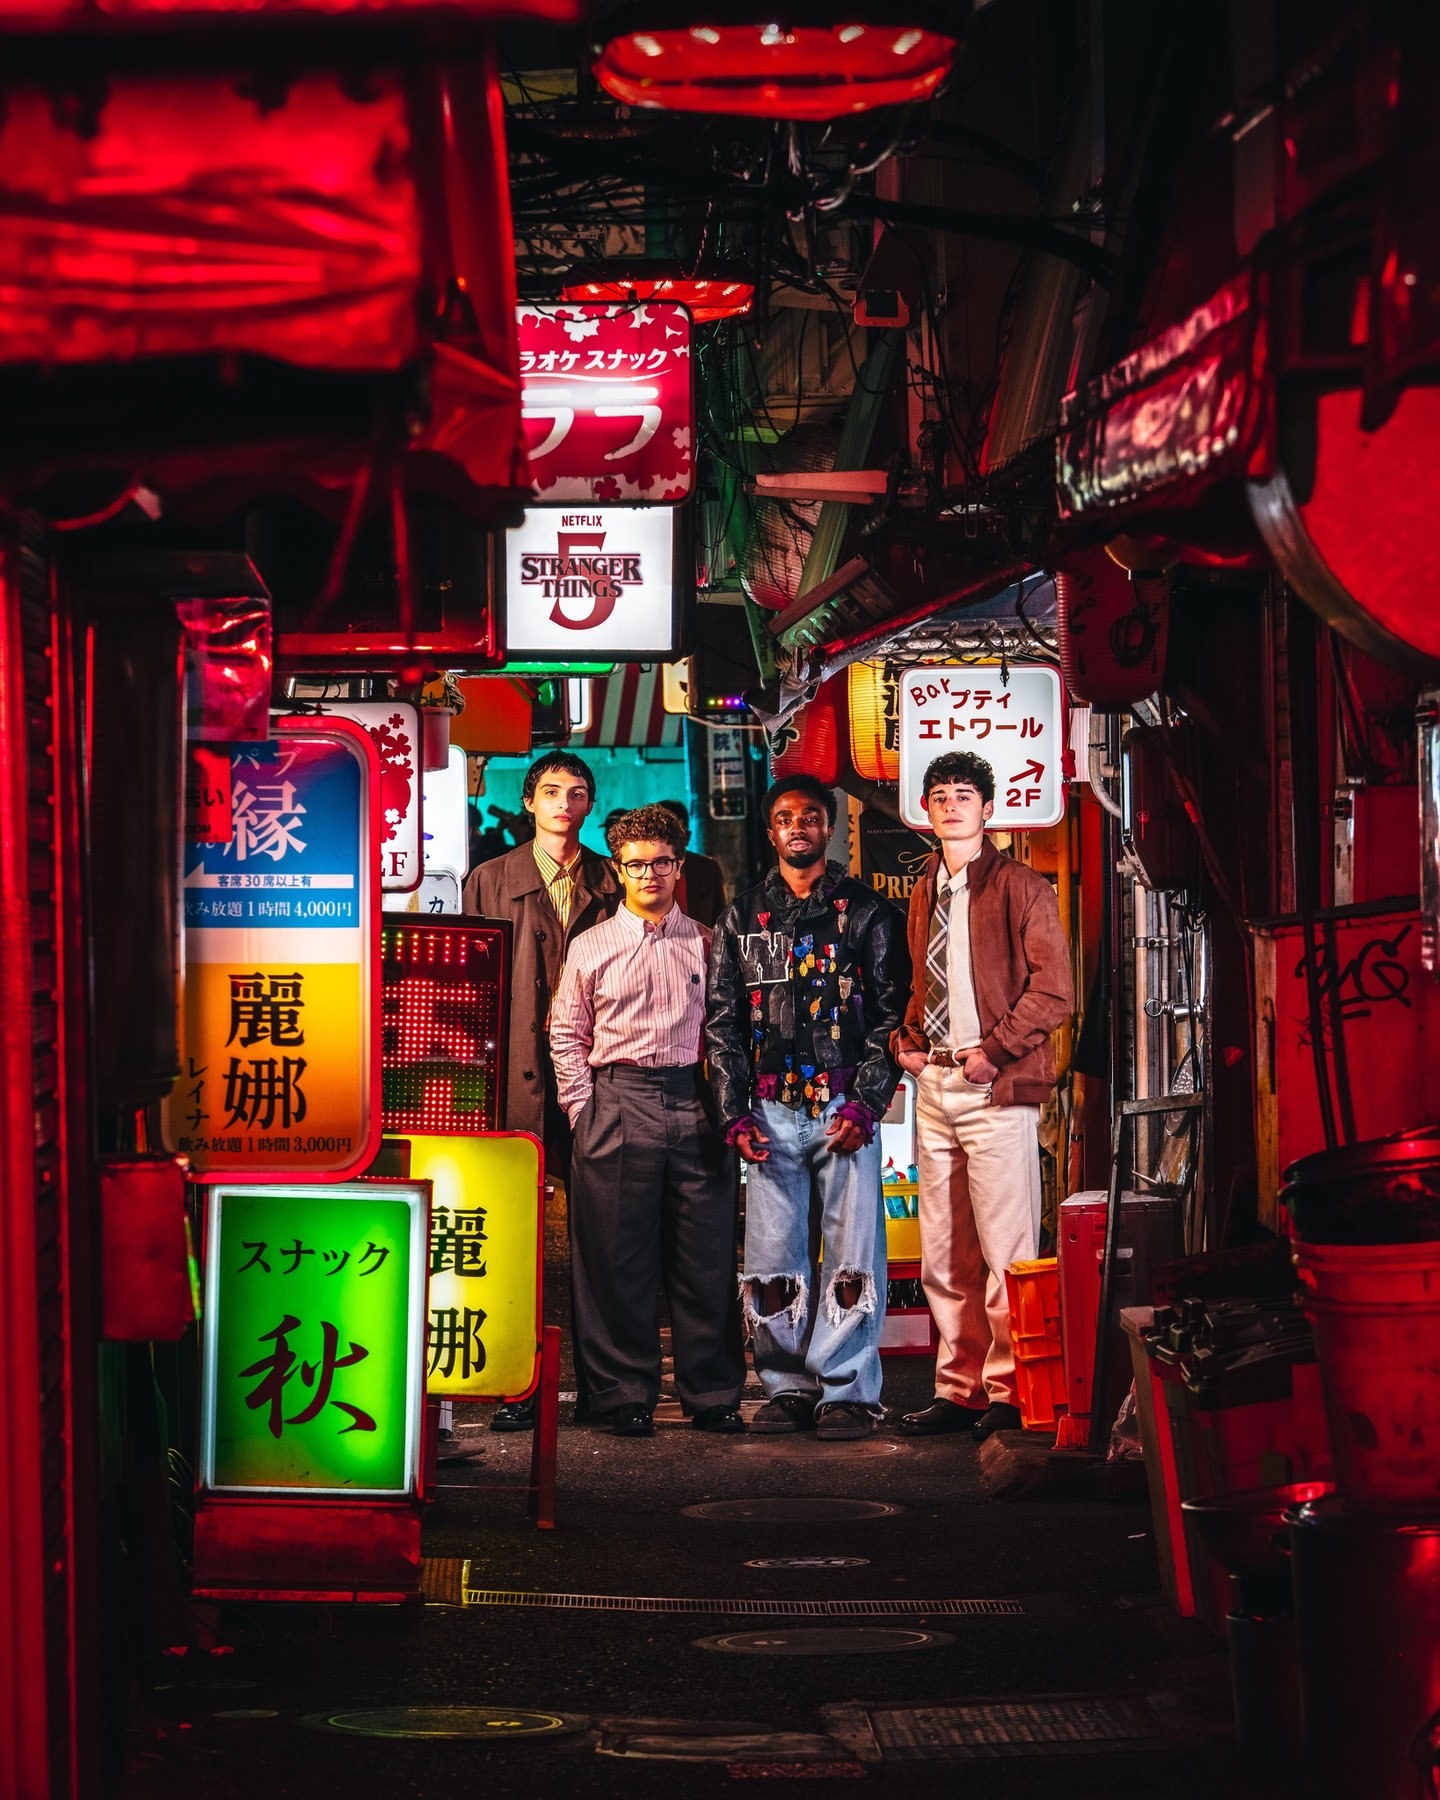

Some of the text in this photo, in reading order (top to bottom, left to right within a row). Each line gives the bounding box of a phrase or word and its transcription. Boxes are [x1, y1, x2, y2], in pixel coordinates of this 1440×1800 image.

[584, 348, 668, 371] スナック
[561, 514, 603, 528] NETFLIX
[521, 555, 644, 583] STRANGER
[549, 531, 617, 631] 5
[540, 579, 624, 599] THINGS
[910, 678, 1012, 710] Bar プティ
[918, 716, 1044, 741] エトワール
[230, 747, 304, 778] パブ
[1005, 787, 1042, 808] 2F
[222, 778, 308, 862] 縁
[381, 850, 408, 878] F
[222, 971, 308, 1132] 麗娜
[185, 1056, 210, 1132] レイナ
[237, 1239, 391, 1277] スナック
[237, 1314, 378, 1439] 秋
